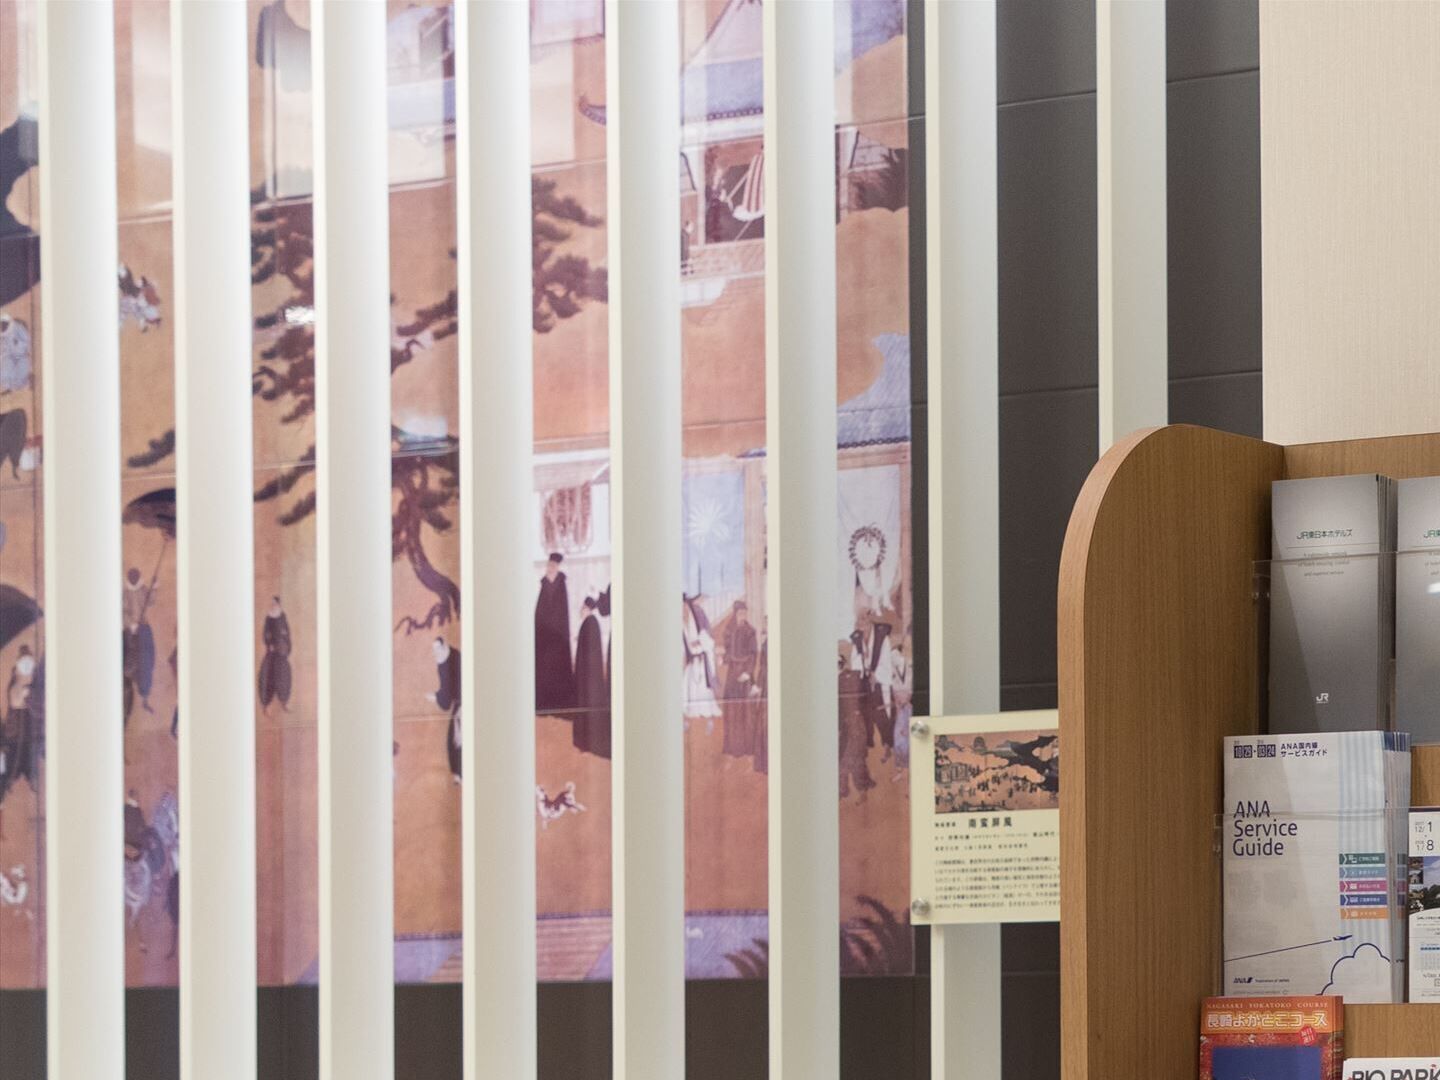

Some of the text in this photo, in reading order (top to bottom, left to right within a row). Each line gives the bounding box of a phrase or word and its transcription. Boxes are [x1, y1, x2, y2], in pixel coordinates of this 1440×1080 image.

[1297, 529, 1353, 540] JR東日本ホテルズ
[1280, 750, 1328, 758] サービスガイド
[1233, 801, 1270, 818] ANA
[1234, 820, 1298, 837] Service
[1233, 839, 1284, 856] Guide
[1207, 1012, 1329, 1028] 長崎よかとこコース
